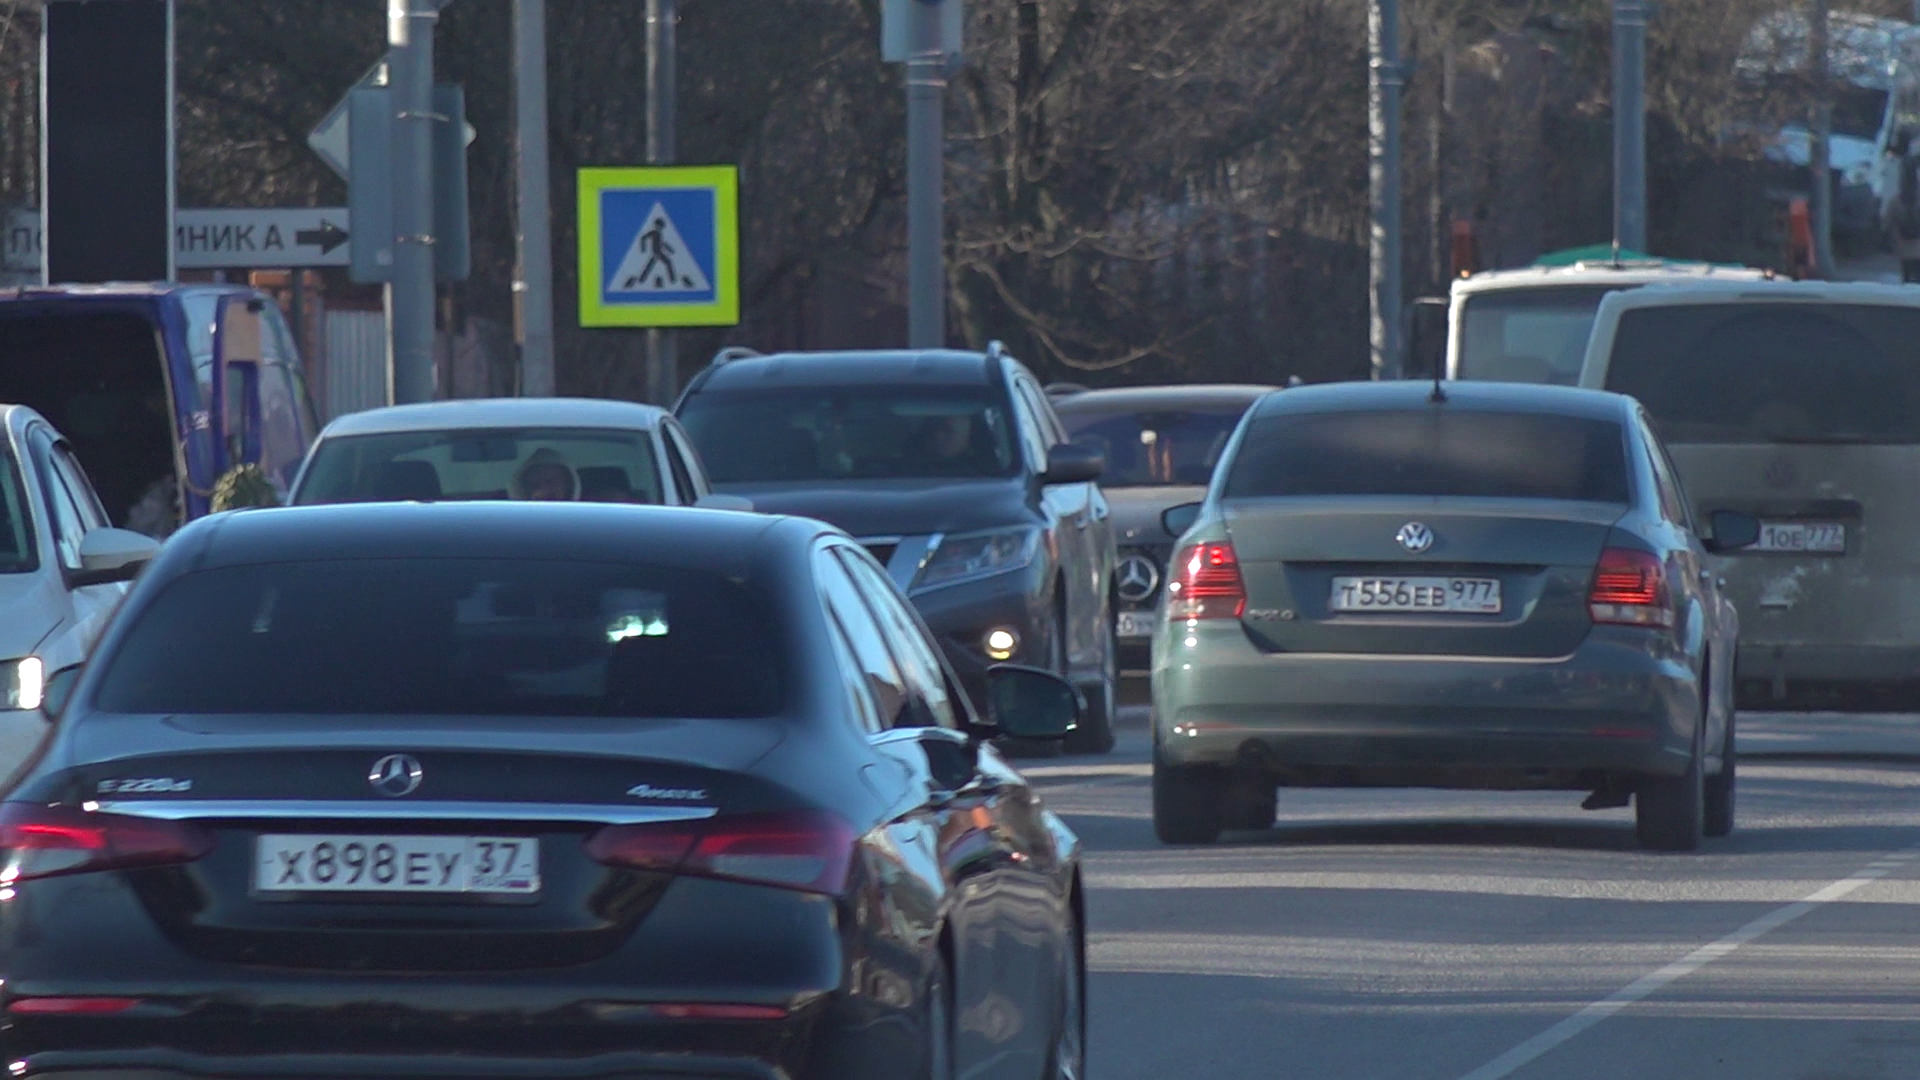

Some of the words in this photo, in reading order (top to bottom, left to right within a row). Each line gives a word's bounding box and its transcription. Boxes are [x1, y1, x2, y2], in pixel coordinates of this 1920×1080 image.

[1765, 528, 1804, 547] 1ОЕ
[1341, 580, 1446, 607] Т556ЕВ
[1452, 580, 1493, 601] 977
[276, 841, 461, 886] Х898ЕУ
[474, 841, 521, 874] 37
